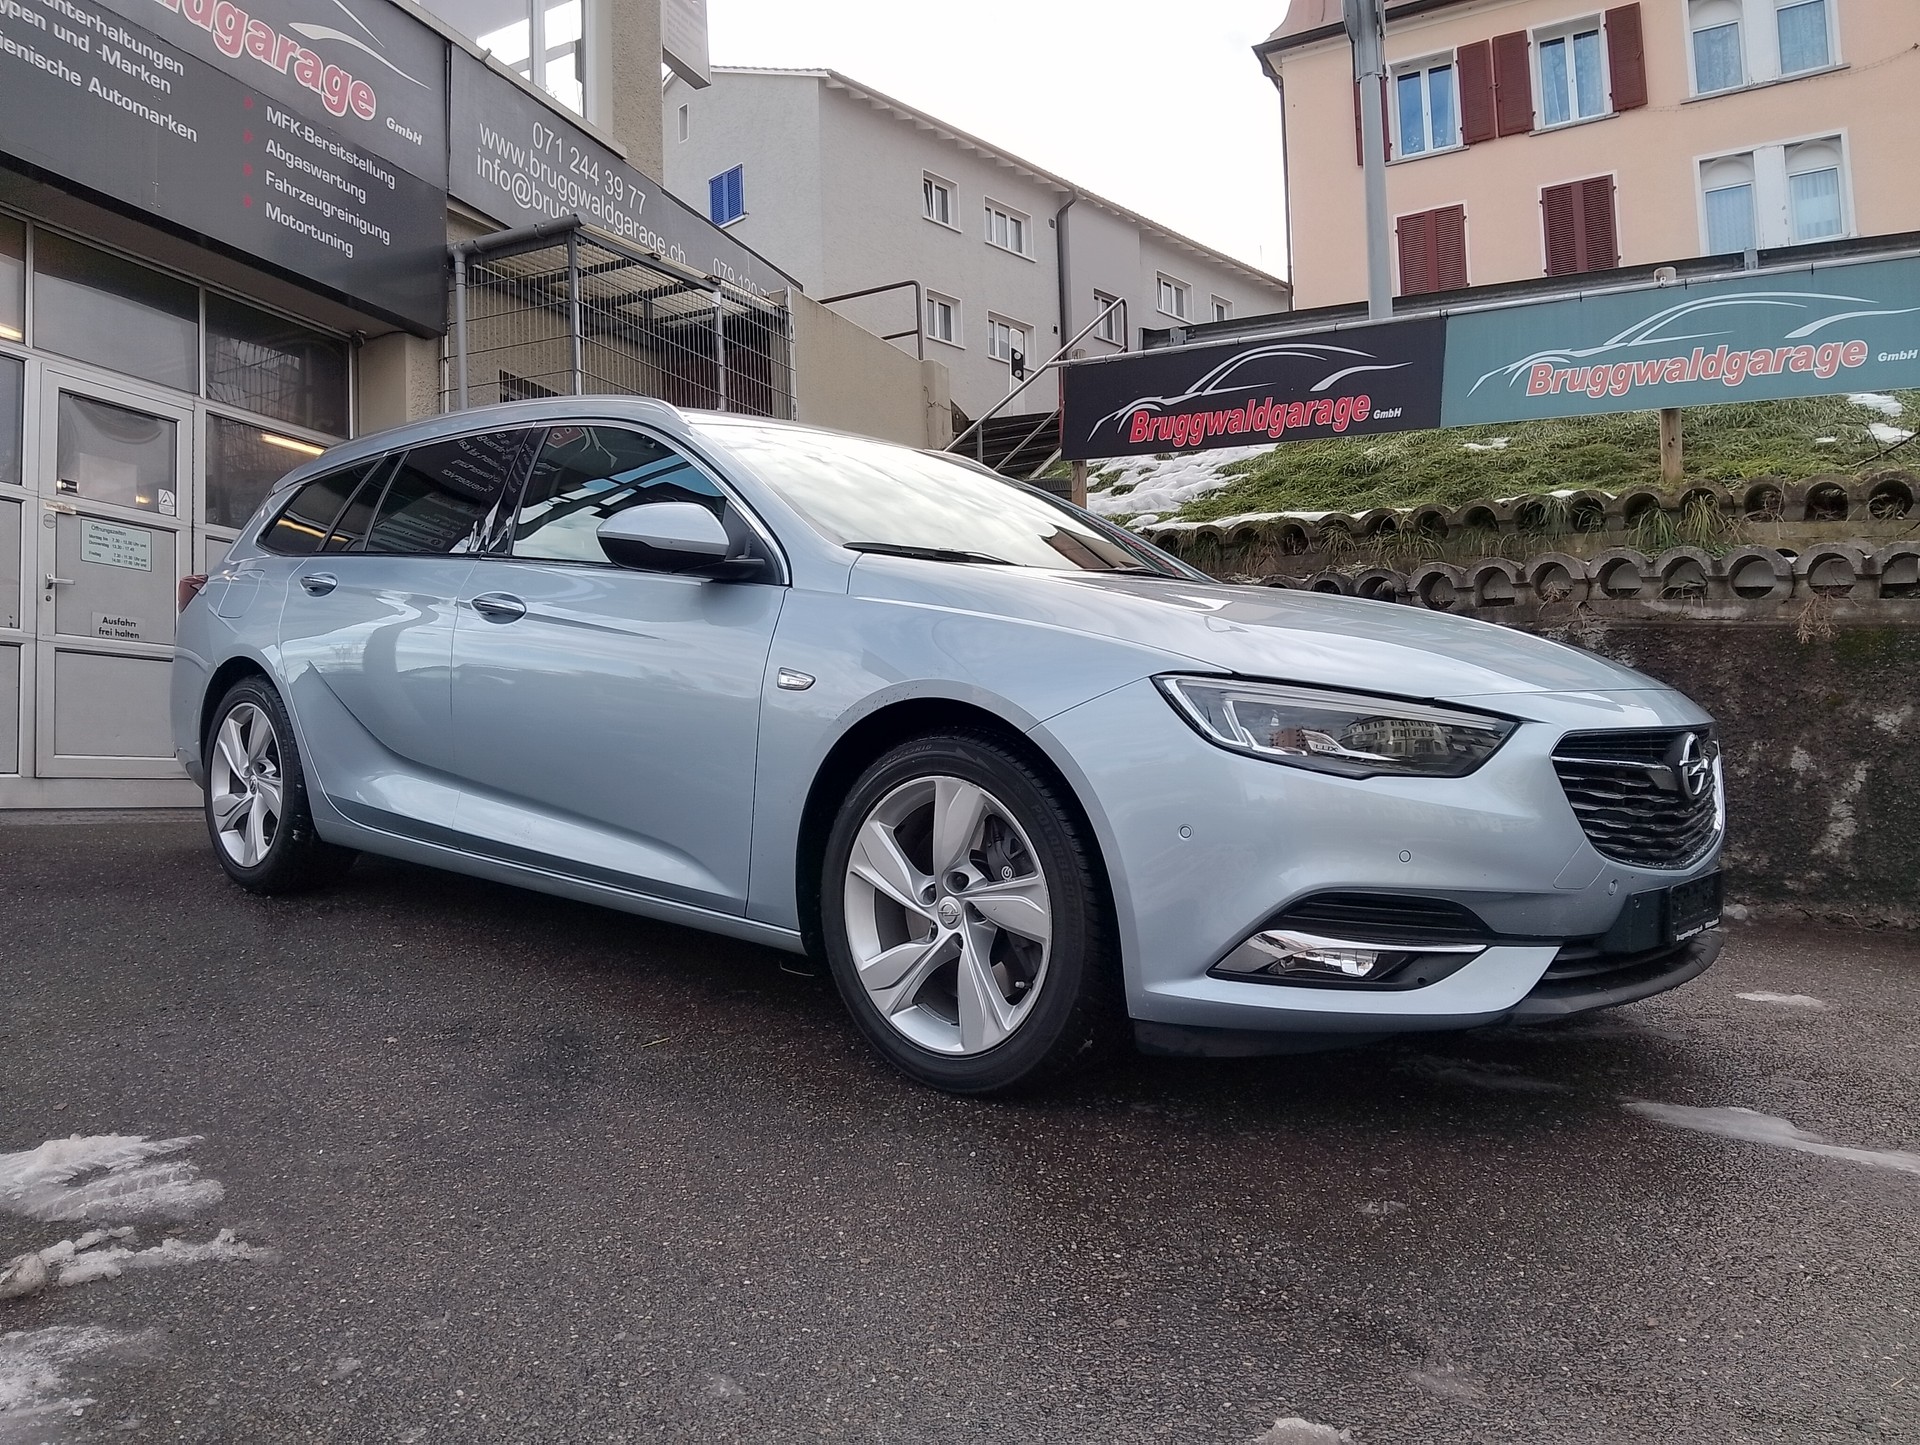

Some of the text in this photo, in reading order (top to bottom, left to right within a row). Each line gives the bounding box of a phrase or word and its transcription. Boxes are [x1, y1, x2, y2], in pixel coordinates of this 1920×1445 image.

[53, 22, 90, 53] und
[96, 43, 171, 95] -Marken
[160, 0, 423, 146] dgarage GmbH
[88, 76, 198, 143] Automarken
[265, 138, 367, 204] Abgaswartung
[266, 105, 396, 189] MFK-Bereitstellung
[533, 121, 646, 215] 071 244 39 77
[265, 169, 390, 245] Fahrzeugreinigung
[480, 122, 686, 264] www.bruggwaldgarage.ch
[265, 202, 354, 258] Motortuning
[1526, 339, 1919, 399] Bruggwaldgarage GmbH
[1129, 394, 1402, 447] Bruggwaldgarage GmbH
[98, 626, 140, 639] frei halten
[102, 616, 137, 628] Ausfahrt
